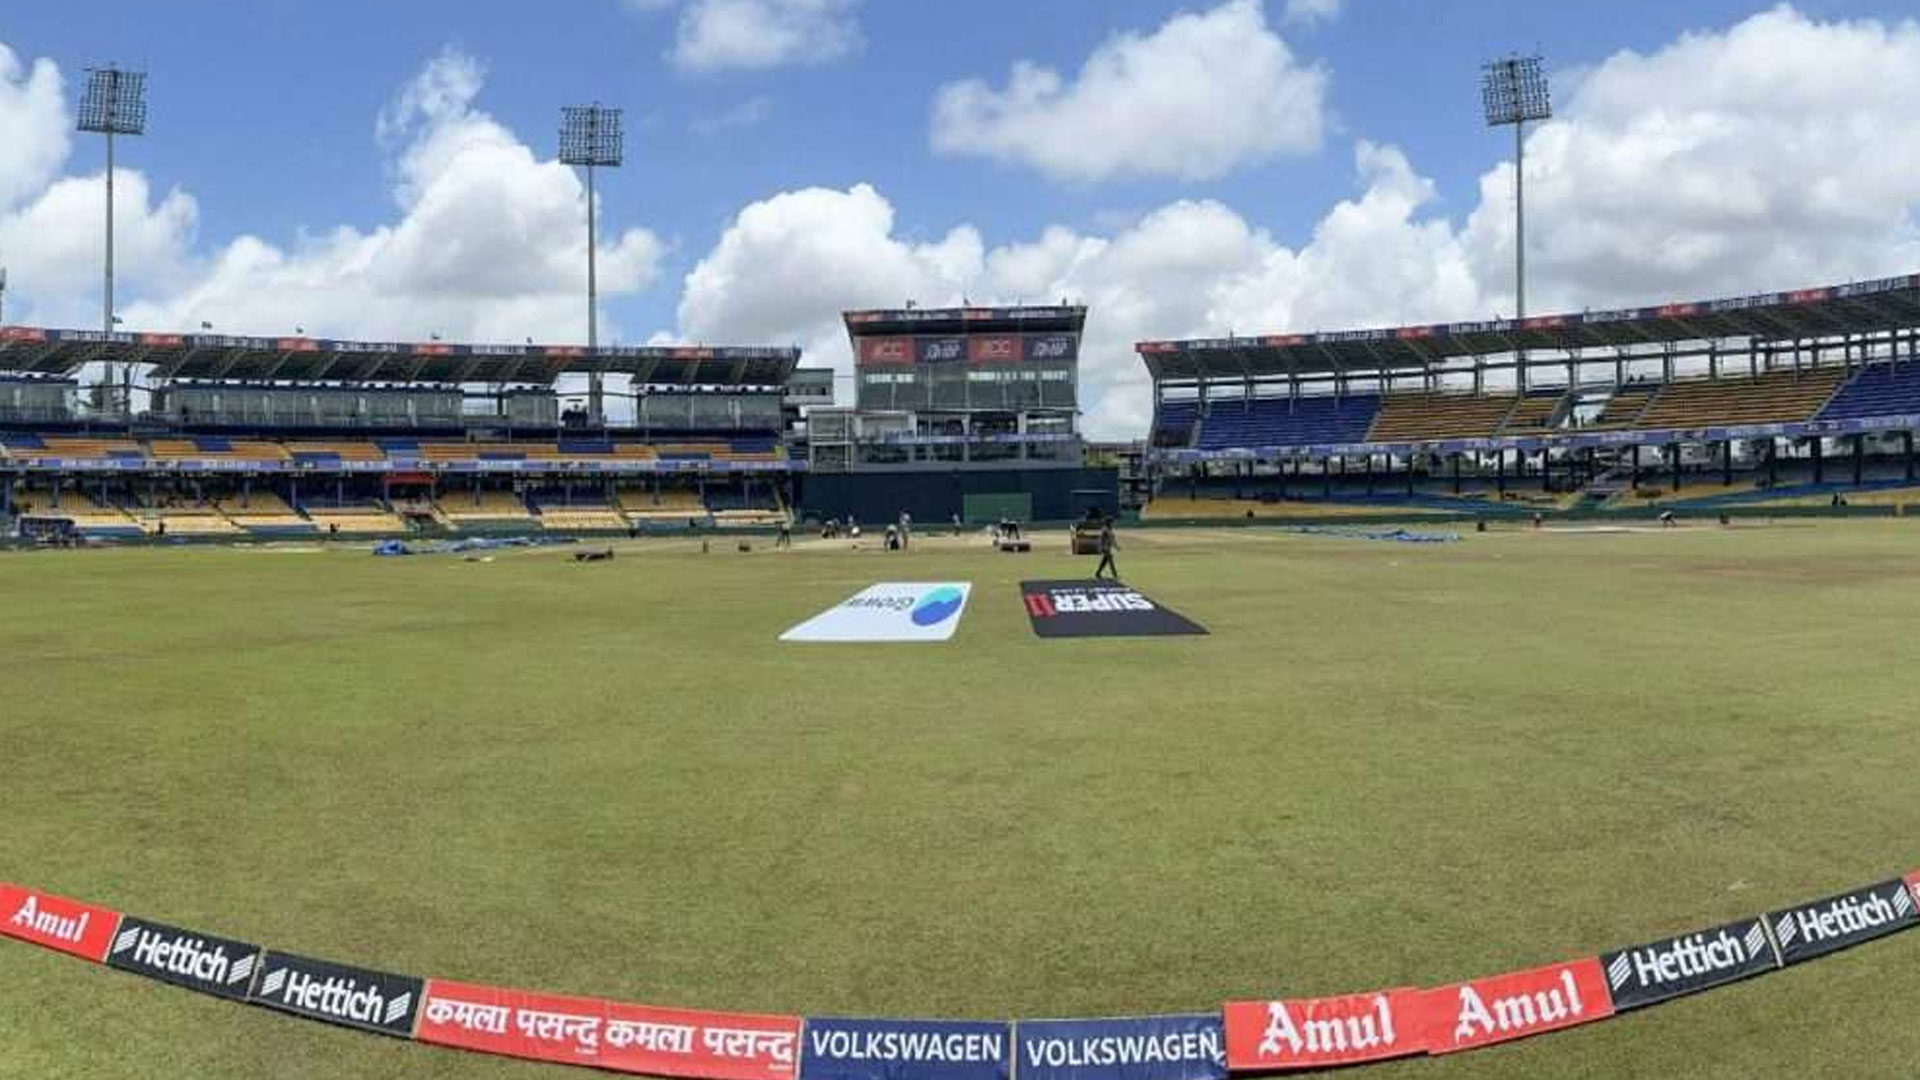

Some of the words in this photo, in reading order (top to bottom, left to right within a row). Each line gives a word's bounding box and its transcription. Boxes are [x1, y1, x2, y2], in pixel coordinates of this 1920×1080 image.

[1054, 592, 1154, 612] SUPER
[12, 895, 89, 941] Amul
[1802, 892, 1896, 944] Hettich
[134, 930, 229, 984] Hettich
[1635, 931, 1744, 987] Hettich
[285, 971, 383, 1023] Hettich
[425, 997, 510, 1034] कमला
[516, 1009, 601, 1047] पसन्द
[1455, 969, 1583, 1043] Amul
[605, 1019, 693, 1055] कमला
[702, 1027, 796, 1063] पसन्द
[812, 1030, 1002, 1062] VOLKSWAGEN
[1026, 1028, 1220, 1067] VOLKSWAGEN
[1258, 993, 1395, 1056] Amul
